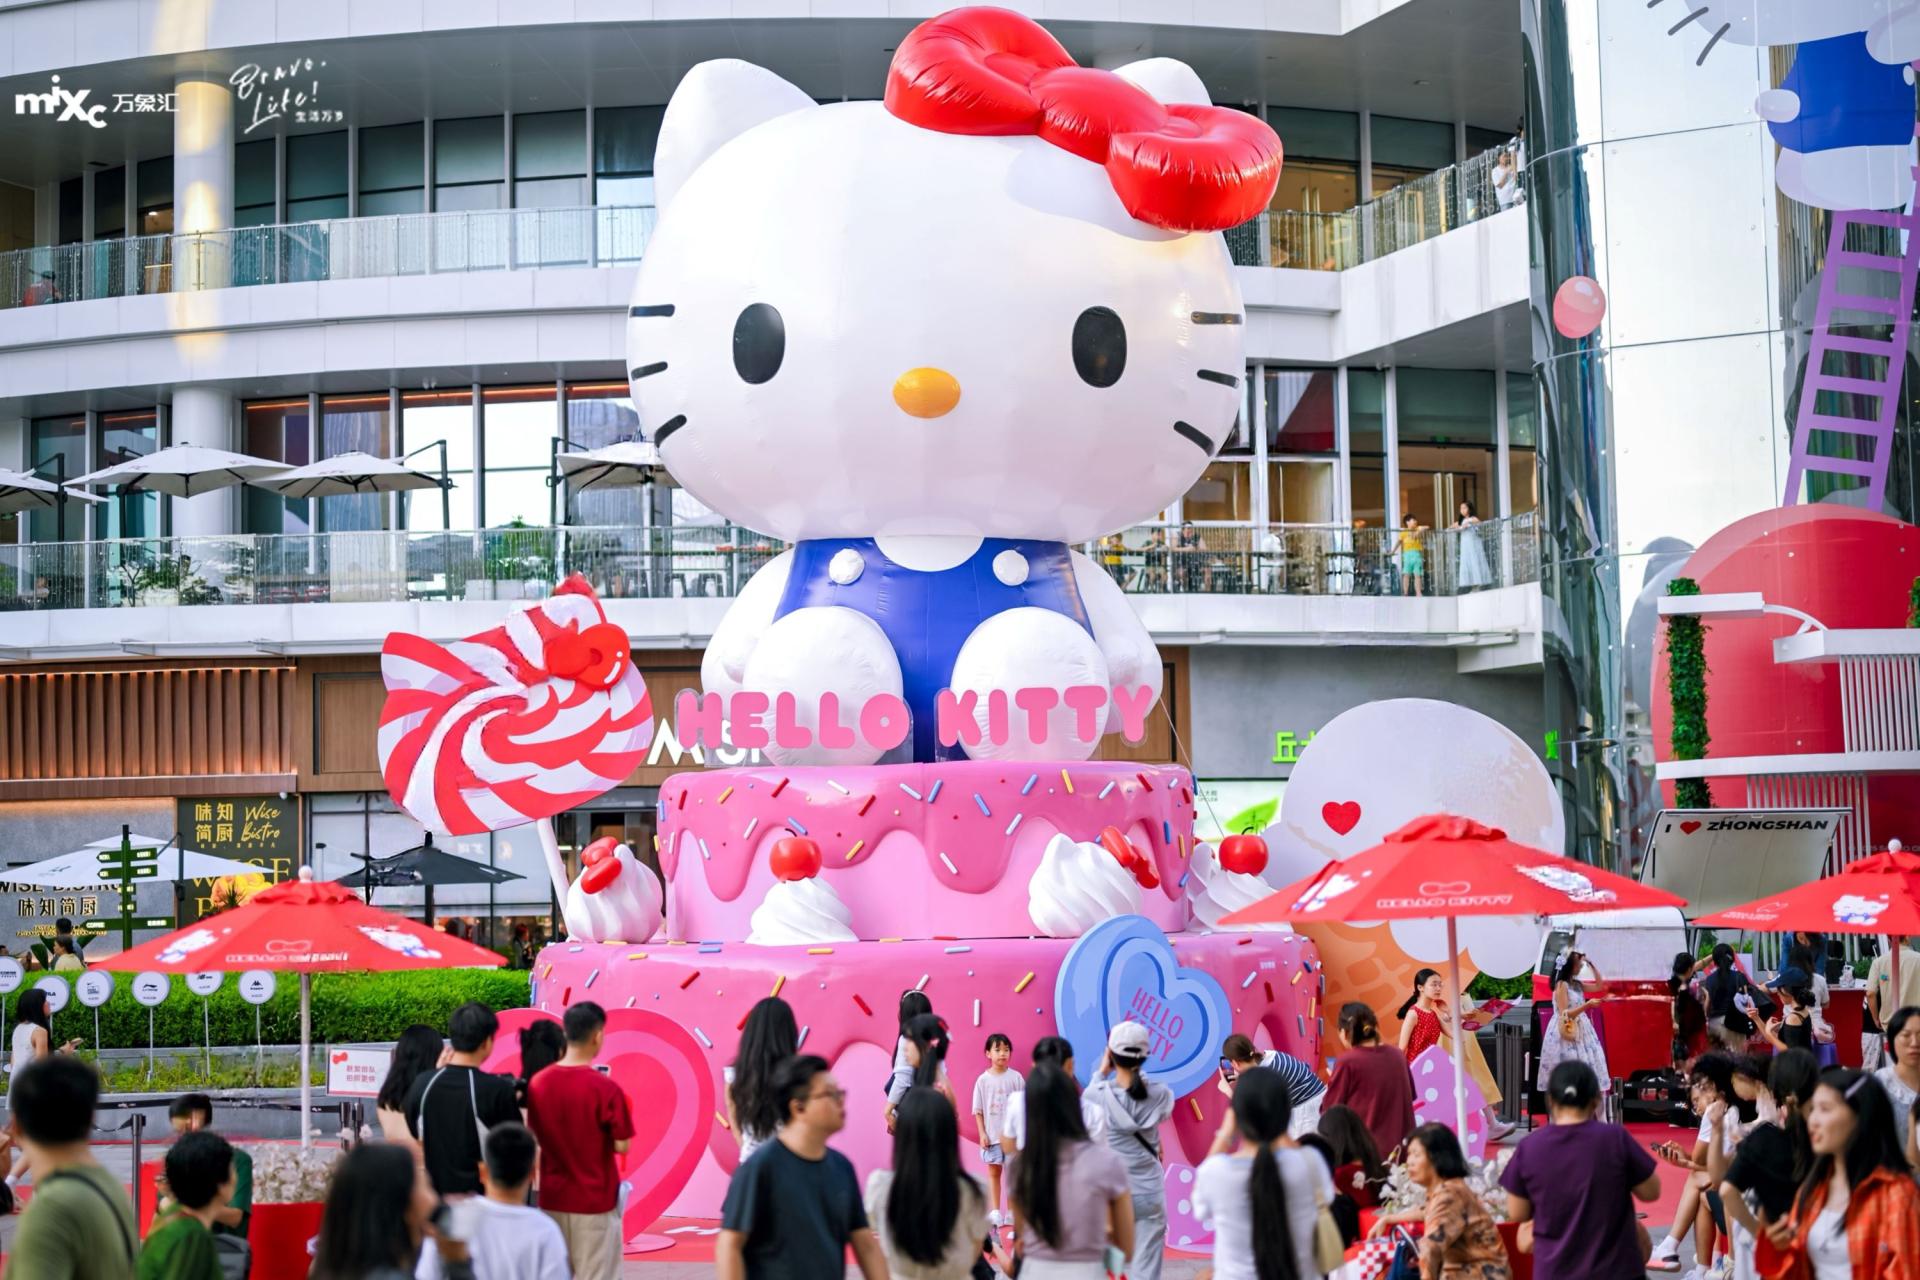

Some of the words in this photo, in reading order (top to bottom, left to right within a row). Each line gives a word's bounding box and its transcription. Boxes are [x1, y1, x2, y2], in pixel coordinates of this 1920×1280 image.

[677, 691, 909, 750] HELLO
[938, 685, 1154, 748] KITTY
[195, 803, 234, 821] 味知
[245, 801, 281, 821] Wise
[195, 824, 234, 842] 简厨
[241, 821, 281, 841] Bistro
[1664, 823, 1673, 833] I
[1706, 819, 1829, 832] ZHONGSHAN
[18, 896, 97, 917] 味知简厨
[1131, 987, 1184, 1040] HELLO
